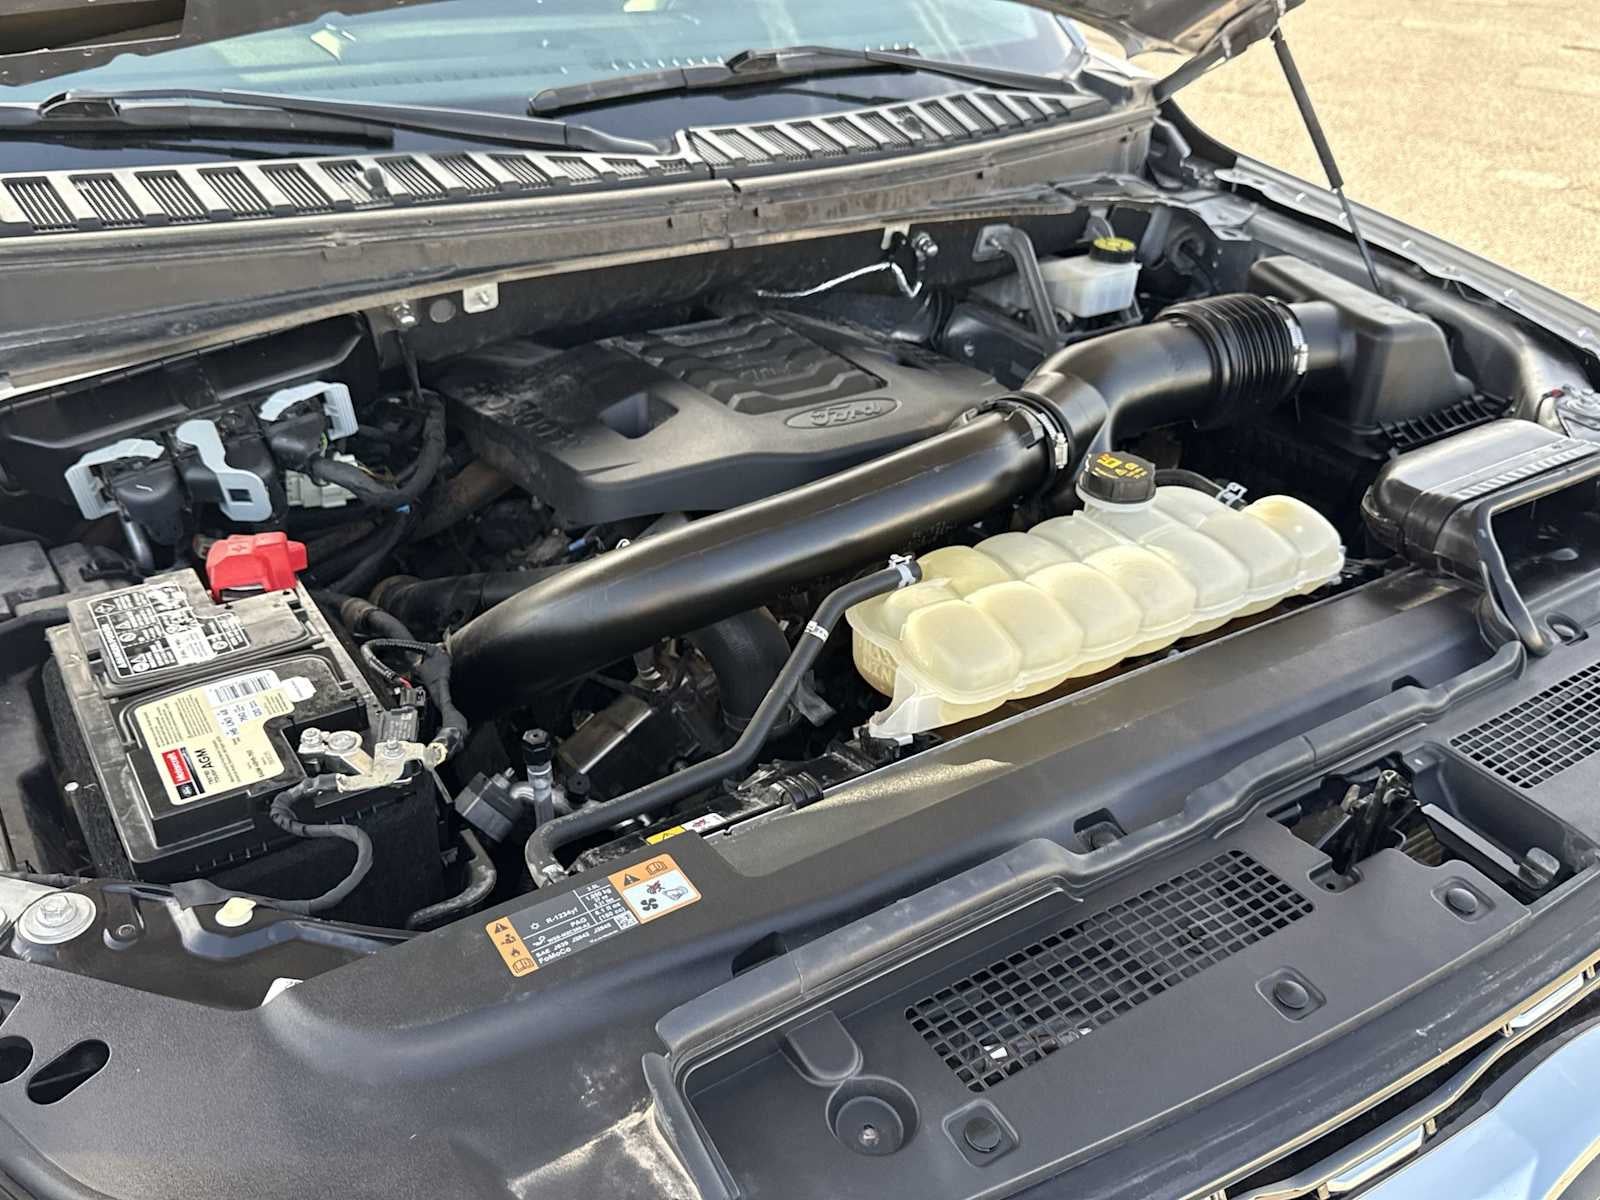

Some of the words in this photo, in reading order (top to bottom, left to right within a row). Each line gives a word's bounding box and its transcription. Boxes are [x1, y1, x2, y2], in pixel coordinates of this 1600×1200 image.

[811, 402, 881, 426] Ford
[167, 752, 186, 783] Motorcraft
[194, 748, 216, 770] AGM
[545, 907, 579, 924] R-1234yf
[570, 917, 587, 928] PAG
[535, 948, 551, 958] SAE
[538, 947, 572, 964] FoMoCo
